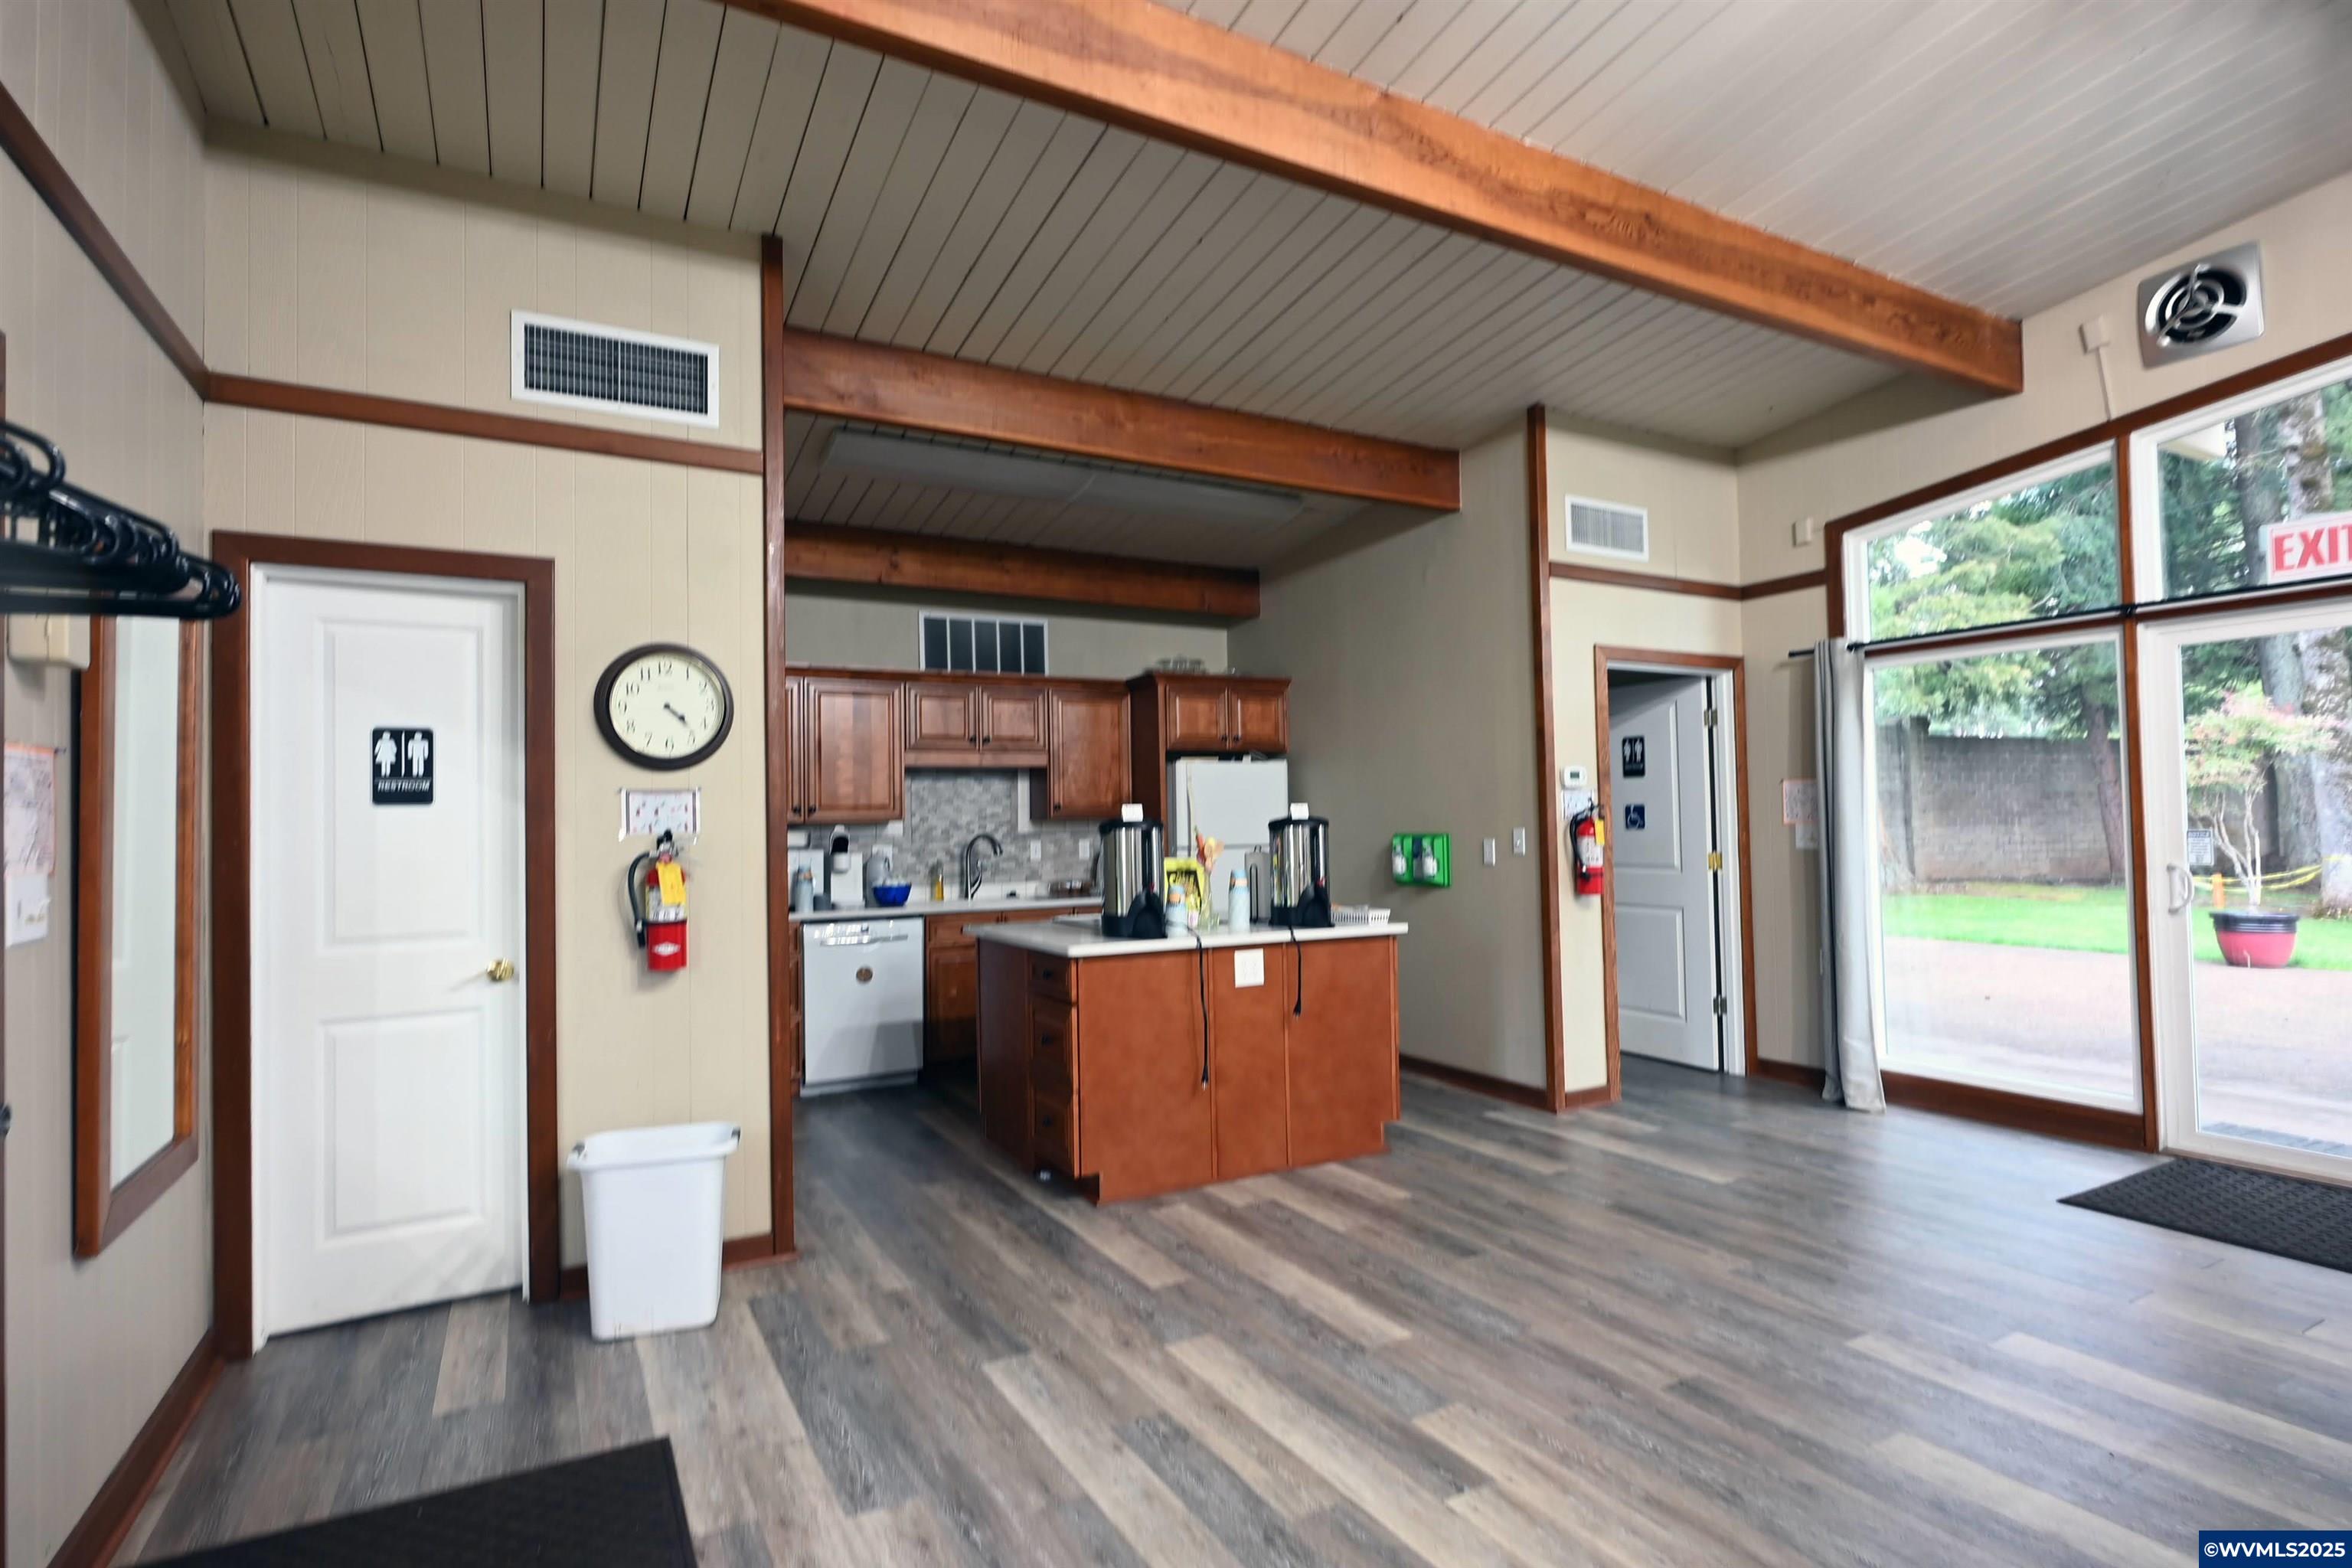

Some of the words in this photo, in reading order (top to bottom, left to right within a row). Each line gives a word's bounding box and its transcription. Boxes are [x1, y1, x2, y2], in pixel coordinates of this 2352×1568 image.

[640, 667, 651, 681] 11
[658, 661, 673, 675] 12
[626, 682, 640, 696] 10
[377, 779, 430, 792] RESTROOM
